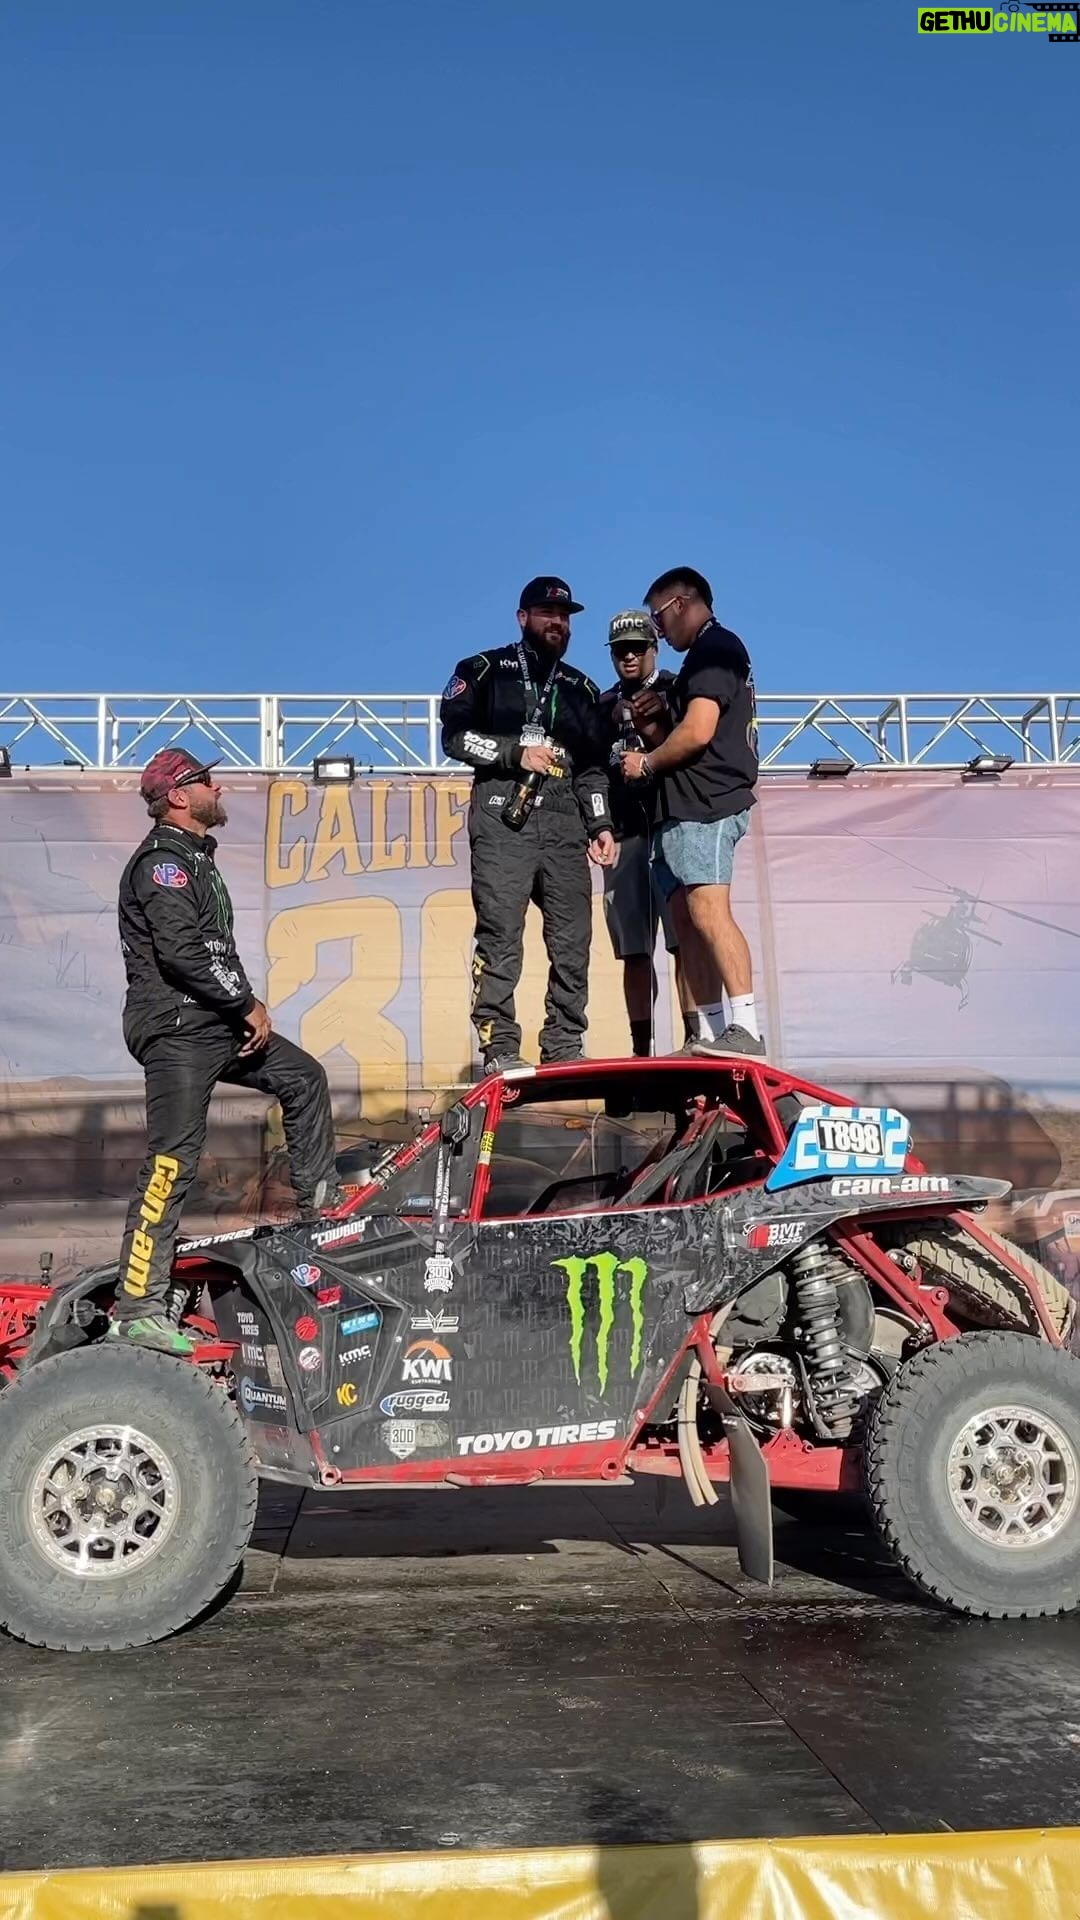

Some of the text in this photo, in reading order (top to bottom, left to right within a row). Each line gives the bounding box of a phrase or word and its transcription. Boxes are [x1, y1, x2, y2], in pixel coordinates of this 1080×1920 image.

[819, 1120, 881, 1155] T898
[831, 1176, 949, 1197] can-am
[176, 1228, 255, 1254] TOYO TIRES
[767, 1222, 806, 1241] BMF
[428, 1266, 450, 1279] 300
[236, 1312, 254, 1324] TOYO
[241, 1324, 259, 1336] TIRES
[402, 1358, 453, 1381] KWI
[245, 1386, 287, 1406] QUANTUM
[336, 1382, 358, 1406] KC
[391, 1428, 414, 1443] 300
[457, 1419, 617, 1456] TOYO TIRES
